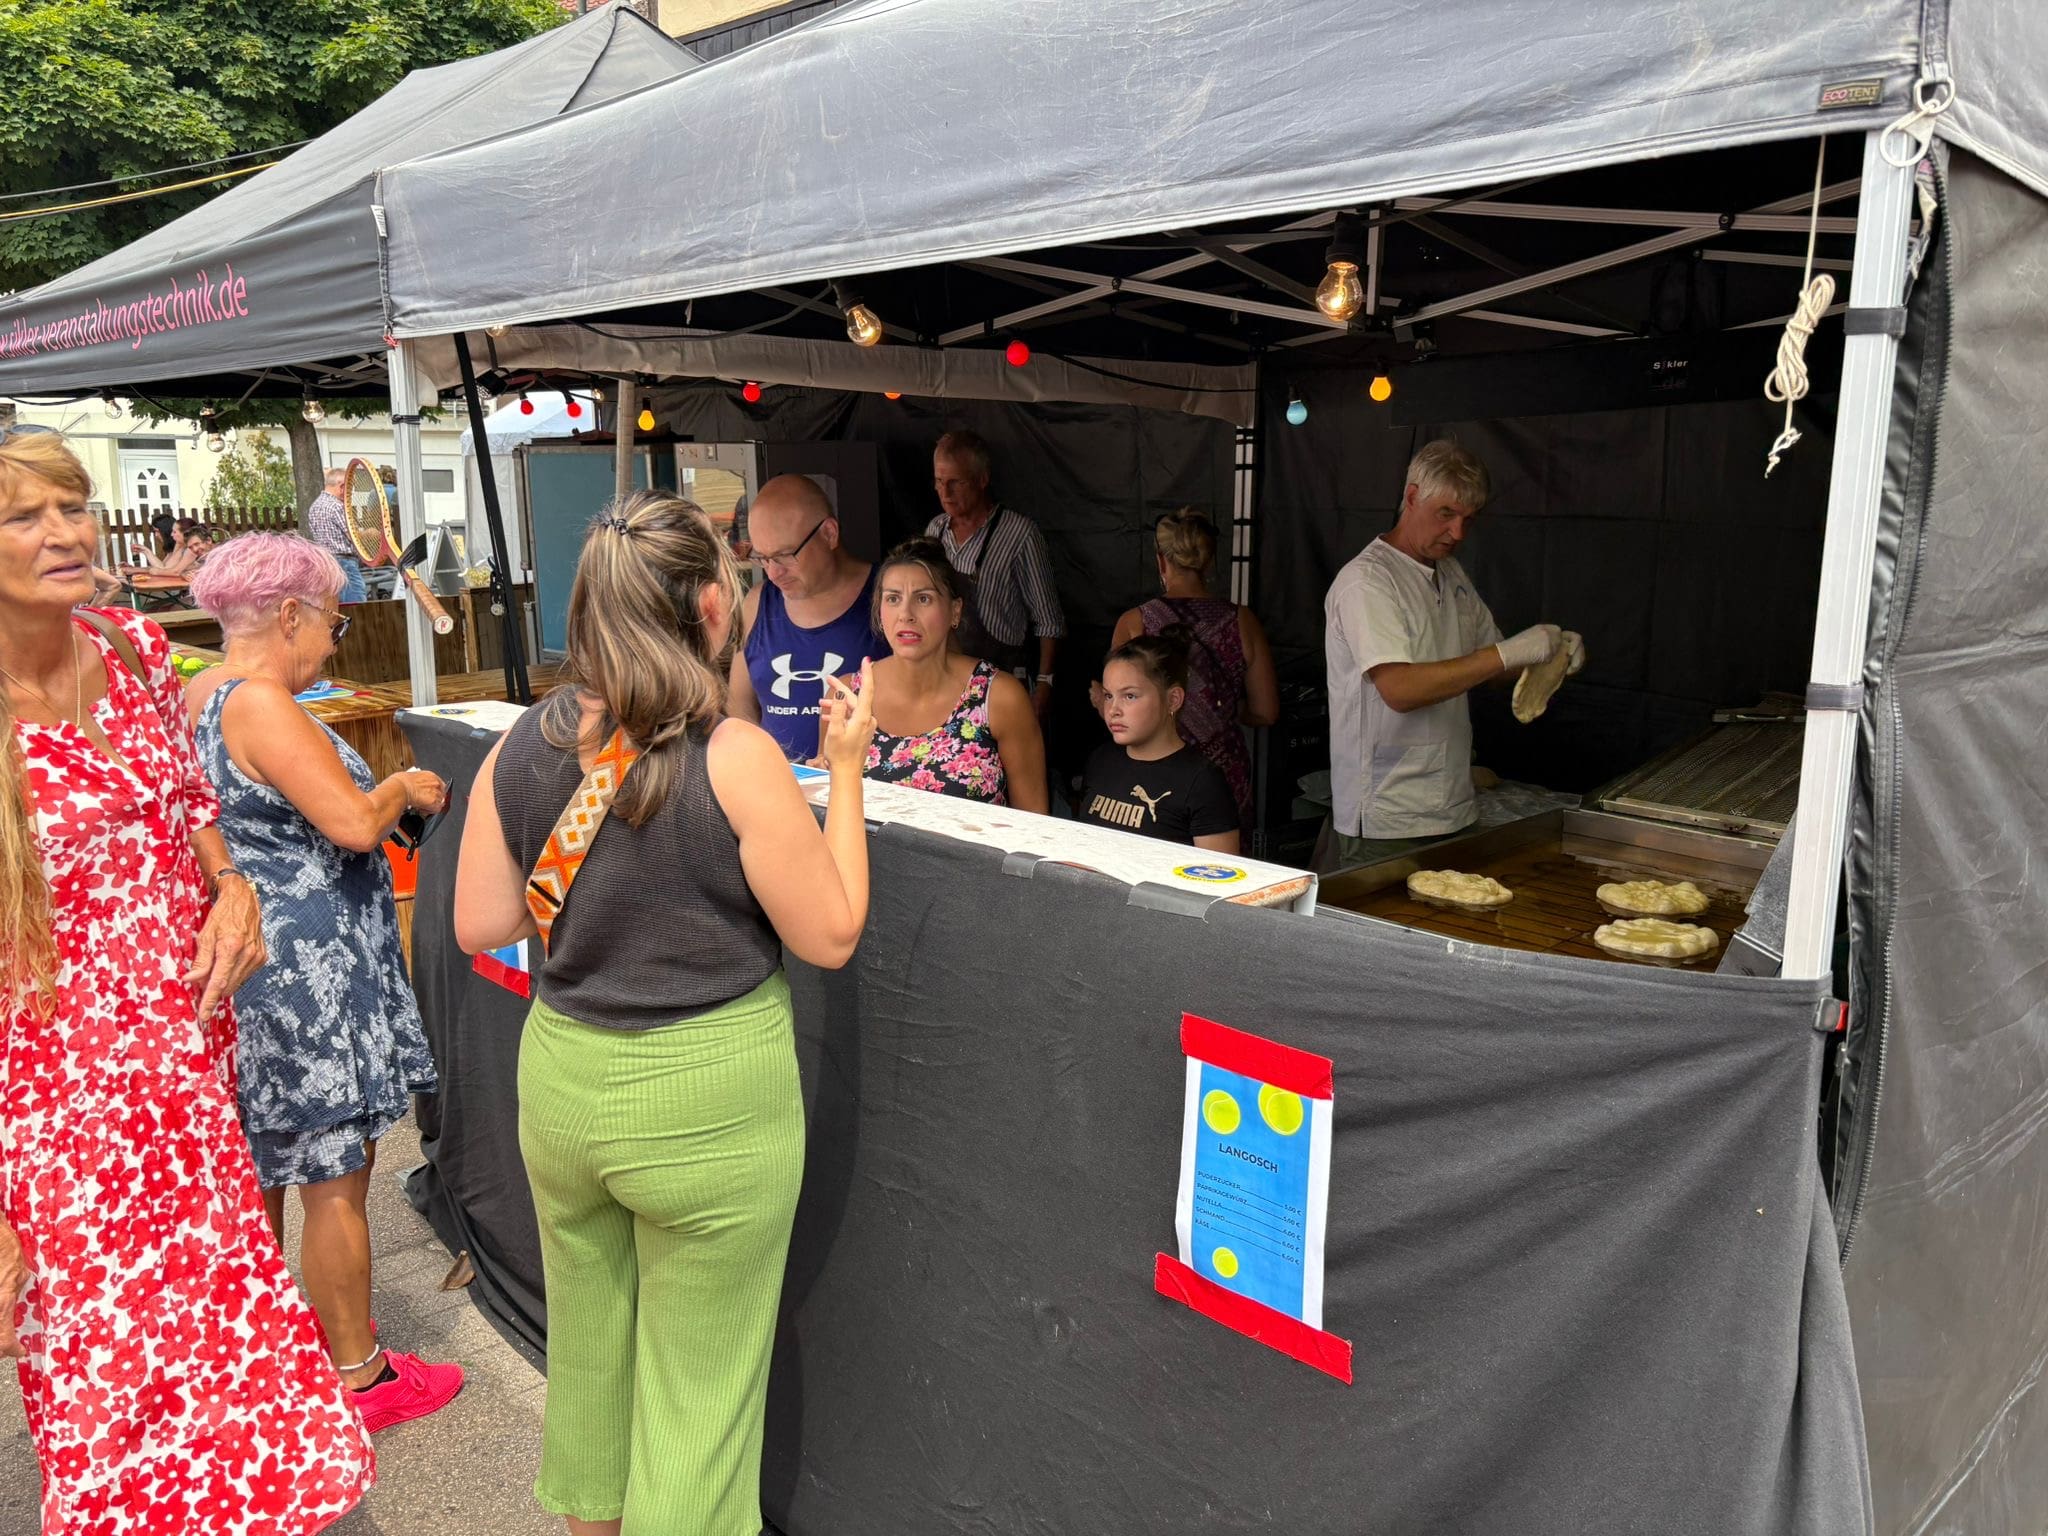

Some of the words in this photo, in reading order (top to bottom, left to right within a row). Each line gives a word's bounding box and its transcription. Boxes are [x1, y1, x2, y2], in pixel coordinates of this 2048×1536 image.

[766, 704, 798, 715] UNDER
[1080, 787, 1121, 812] PUMA
[1219, 1143, 1278, 1173] LANGOSCH
[1196, 1194, 1222, 1208] NUTELLA
[1195, 1206, 1225, 1221] SCHMAND
